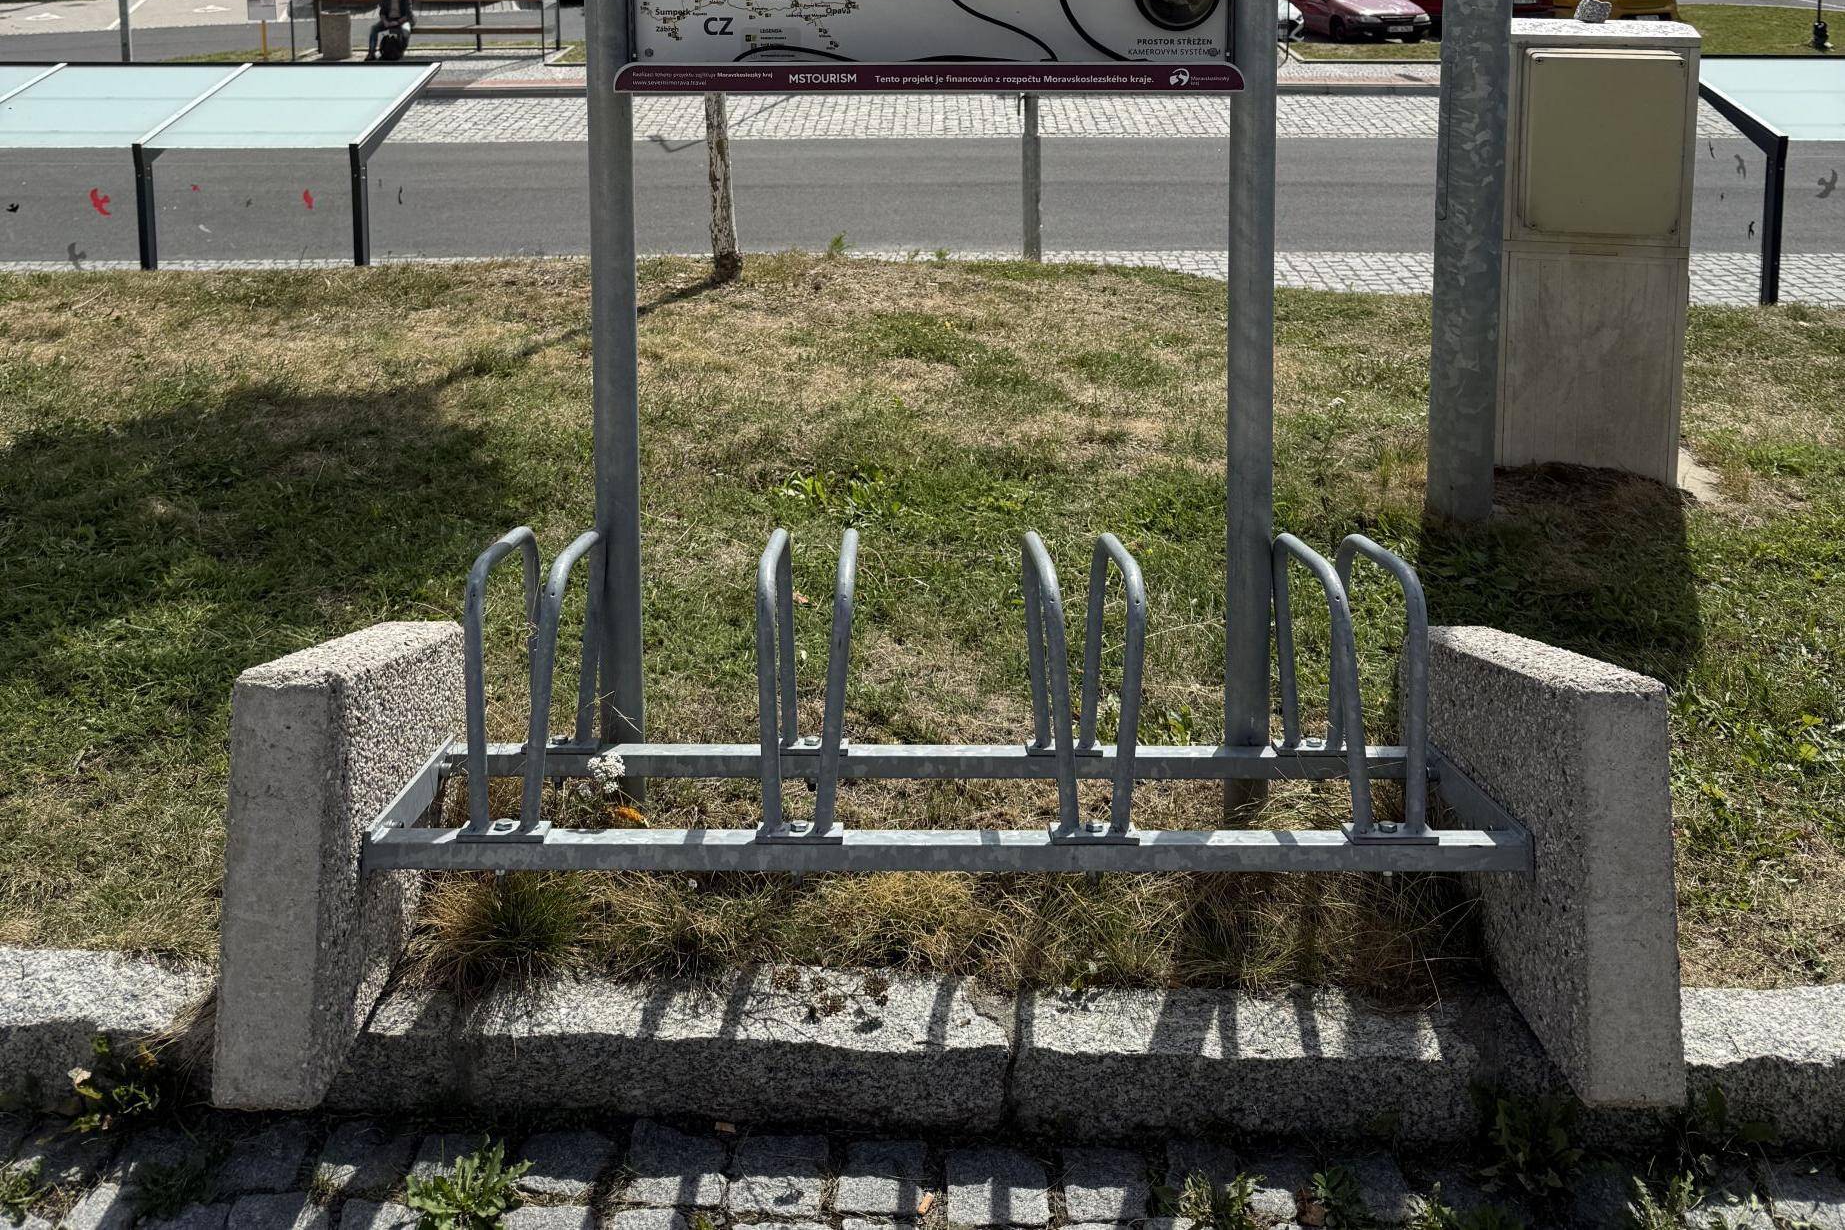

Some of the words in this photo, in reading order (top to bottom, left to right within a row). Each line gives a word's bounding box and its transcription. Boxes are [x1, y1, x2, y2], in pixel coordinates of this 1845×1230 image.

[825, 7, 851, 15] Opava
[703, 16, 734, 36] CZ
[1137, 38, 1175, 46] PROSTOR
[1176, 37, 1213, 46] STŘEŽEN
[1180, 47, 1220, 56] SYSTÉM
[789, 73, 857, 84] MSTOURISM
[875, 75, 900, 83] Tento
[902, 75, 934, 85] projekt
[935, 75, 944, 85] je
[946, 75, 994, 83] financován
[1003, 75, 1041, 85] rozpočtu
[1044, 75, 1128, 83] Moravskoslezského
[1129, 75, 1155, 85] kraje.
